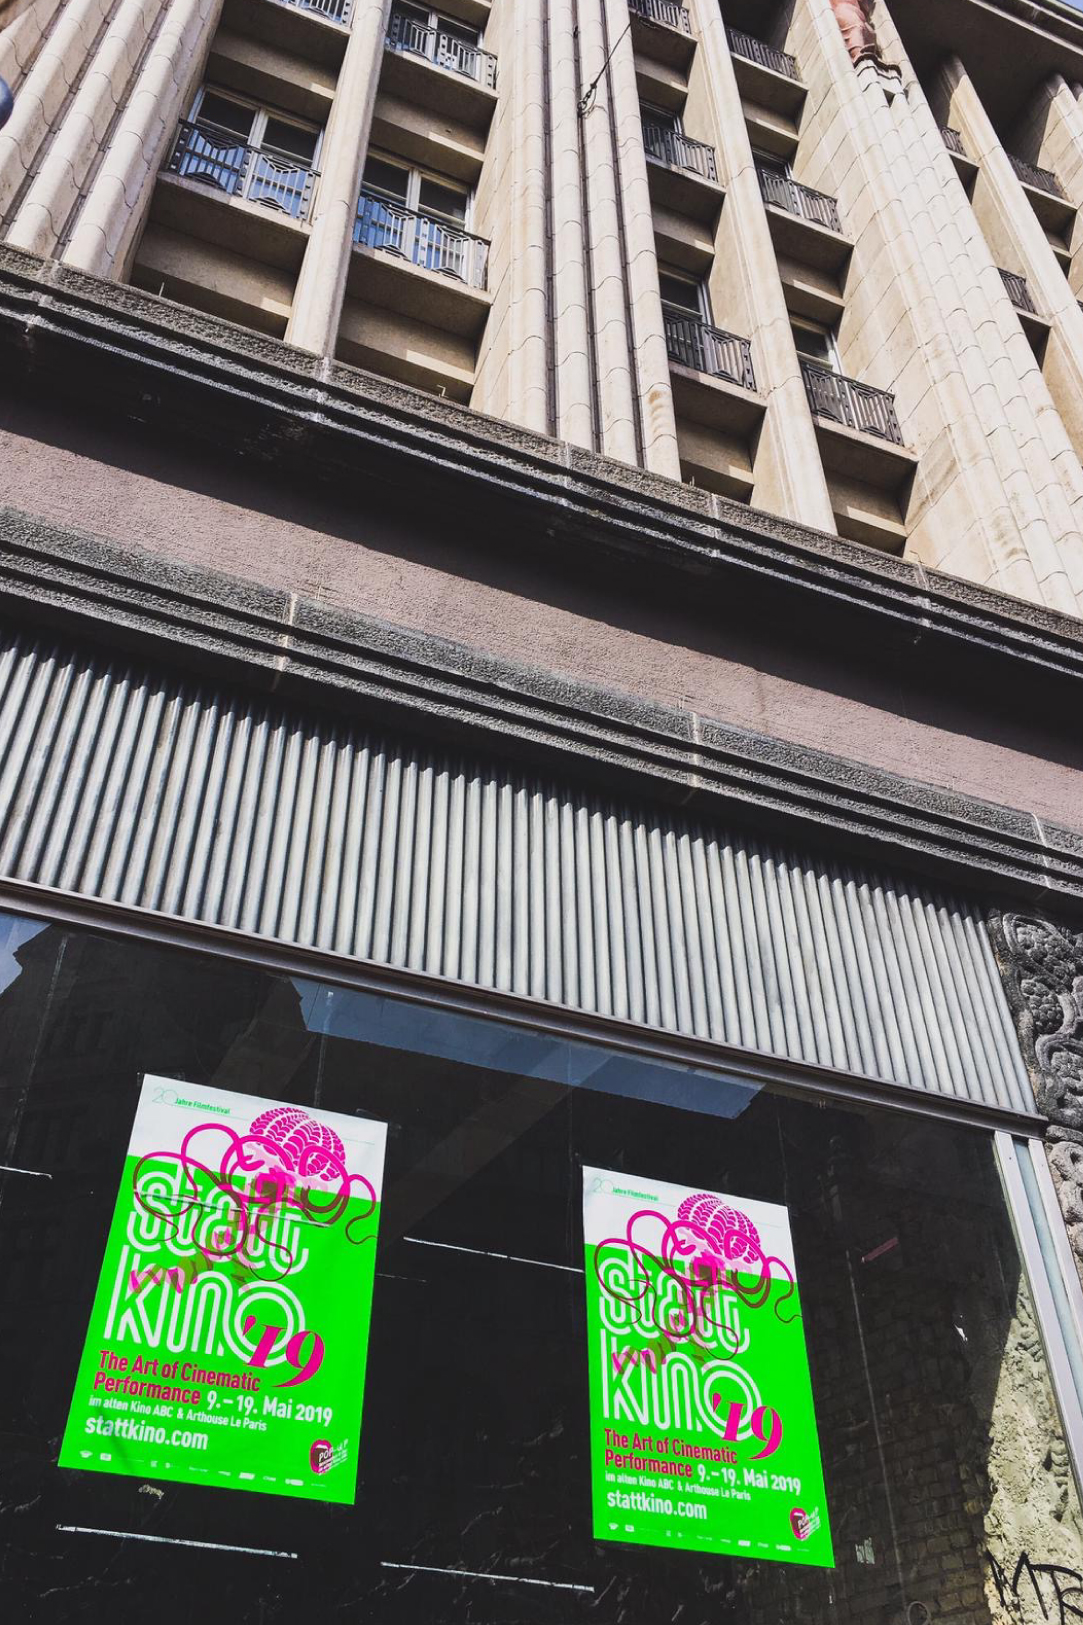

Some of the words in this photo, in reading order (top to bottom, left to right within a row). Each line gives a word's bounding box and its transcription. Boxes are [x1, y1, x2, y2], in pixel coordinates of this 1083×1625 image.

[175, 1098, 193, 1107] Jahre
[193, 1100, 231, 1115] Filmfestival
[103, 1245, 306, 1367] kino
[100, 1350, 128, 1371] The
[132, 1355, 159, 1376] Art
[161, 1361, 180, 1380] of
[181, 1362, 261, 1392] Cinematic
[600, 1328, 763, 1441] kino
[89, 1395, 102, 1407] im
[103, 1397, 128, 1411] alten
[130, 1400, 151, 1415] Kino
[152, 1404, 174, 1418] ABC
[177, 1407, 184, 1420] &
[186, 1409, 229, 1426] Arthouse
[230, 1415, 242, 1428] Le
[243, 1418, 268, 1431] Paris
[94, 1371, 201, 1405] Performance
[262, 1395, 293, 1419] Mai
[295, 1404, 333, 1427] 2019
[85, 1415, 209, 1450] stattkino.com
[605, 1428, 629, 1448] The
[632, 1432, 653, 1452] Art
[656, 1437, 670, 1454] of
[672, 1438, 738, 1465] Cinematic
[605, 1448, 693, 1478] Performance
[743, 1468, 769, 1489] Mai
[770, 1475, 801, 1496] 2019
[605, 1470, 616, 1482] im
[639, 1475, 657, 1488] Kino
[658, 1478, 674, 1490] ABC
[685, 1482, 720, 1497] Arthouse
[721, 1487, 730, 1499] Le
[731, 1488, 752, 1501] Paris
[606, 1490, 708, 1520] stattkino.com
